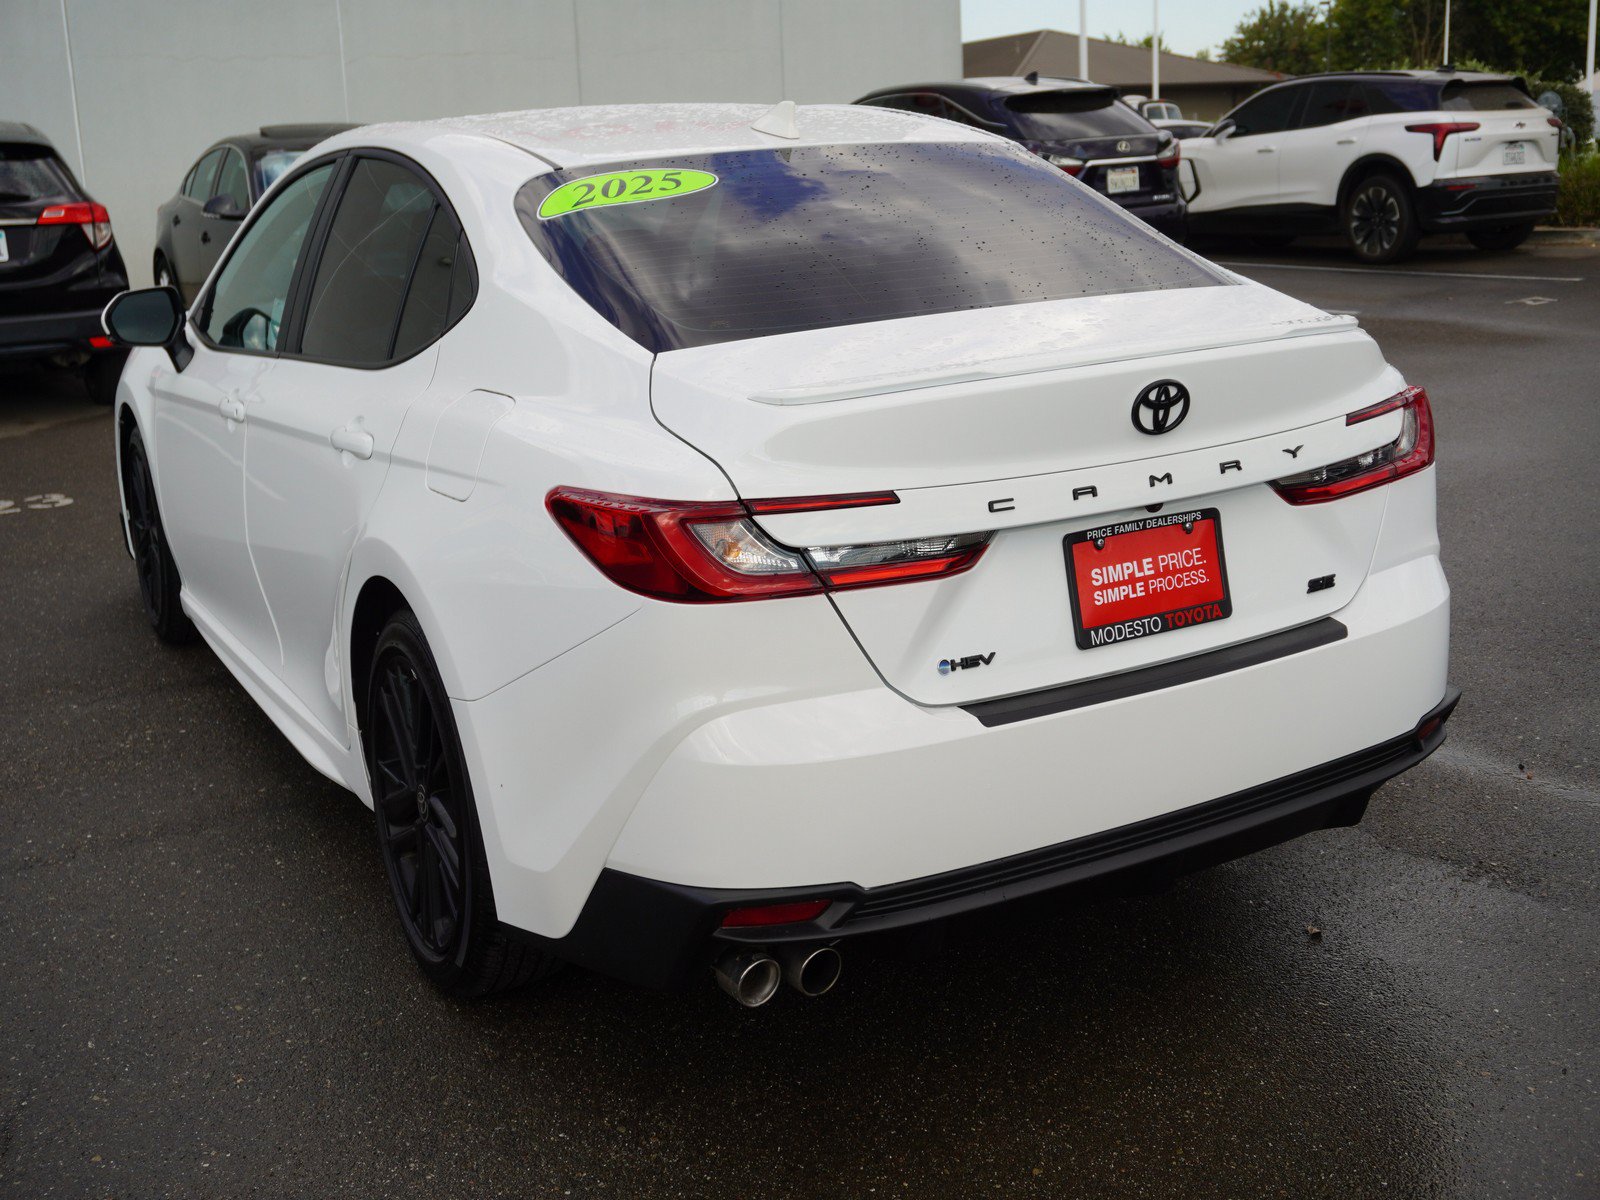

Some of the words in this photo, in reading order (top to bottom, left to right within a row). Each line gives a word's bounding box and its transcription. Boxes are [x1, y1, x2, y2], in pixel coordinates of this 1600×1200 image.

[571, 171, 682, 209] 2025
[988, 444, 1304, 513] CAMRY
[1086, 526, 1112, 540] PRICE
[1114, 520, 1144, 534] FAMILY
[1145, 511, 1202, 529] DEALERSHIPS
[1091, 557, 1154, 586] SIMPLE
[1158, 547, 1207, 573] PRICE.
[1093, 581, 1145, 606] SIMPLE
[1149, 568, 1210, 594] PROCESS.
[1090, 616, 1162, 646] MODESTO
[1165, 603, 1223, 629] TOYOTA
